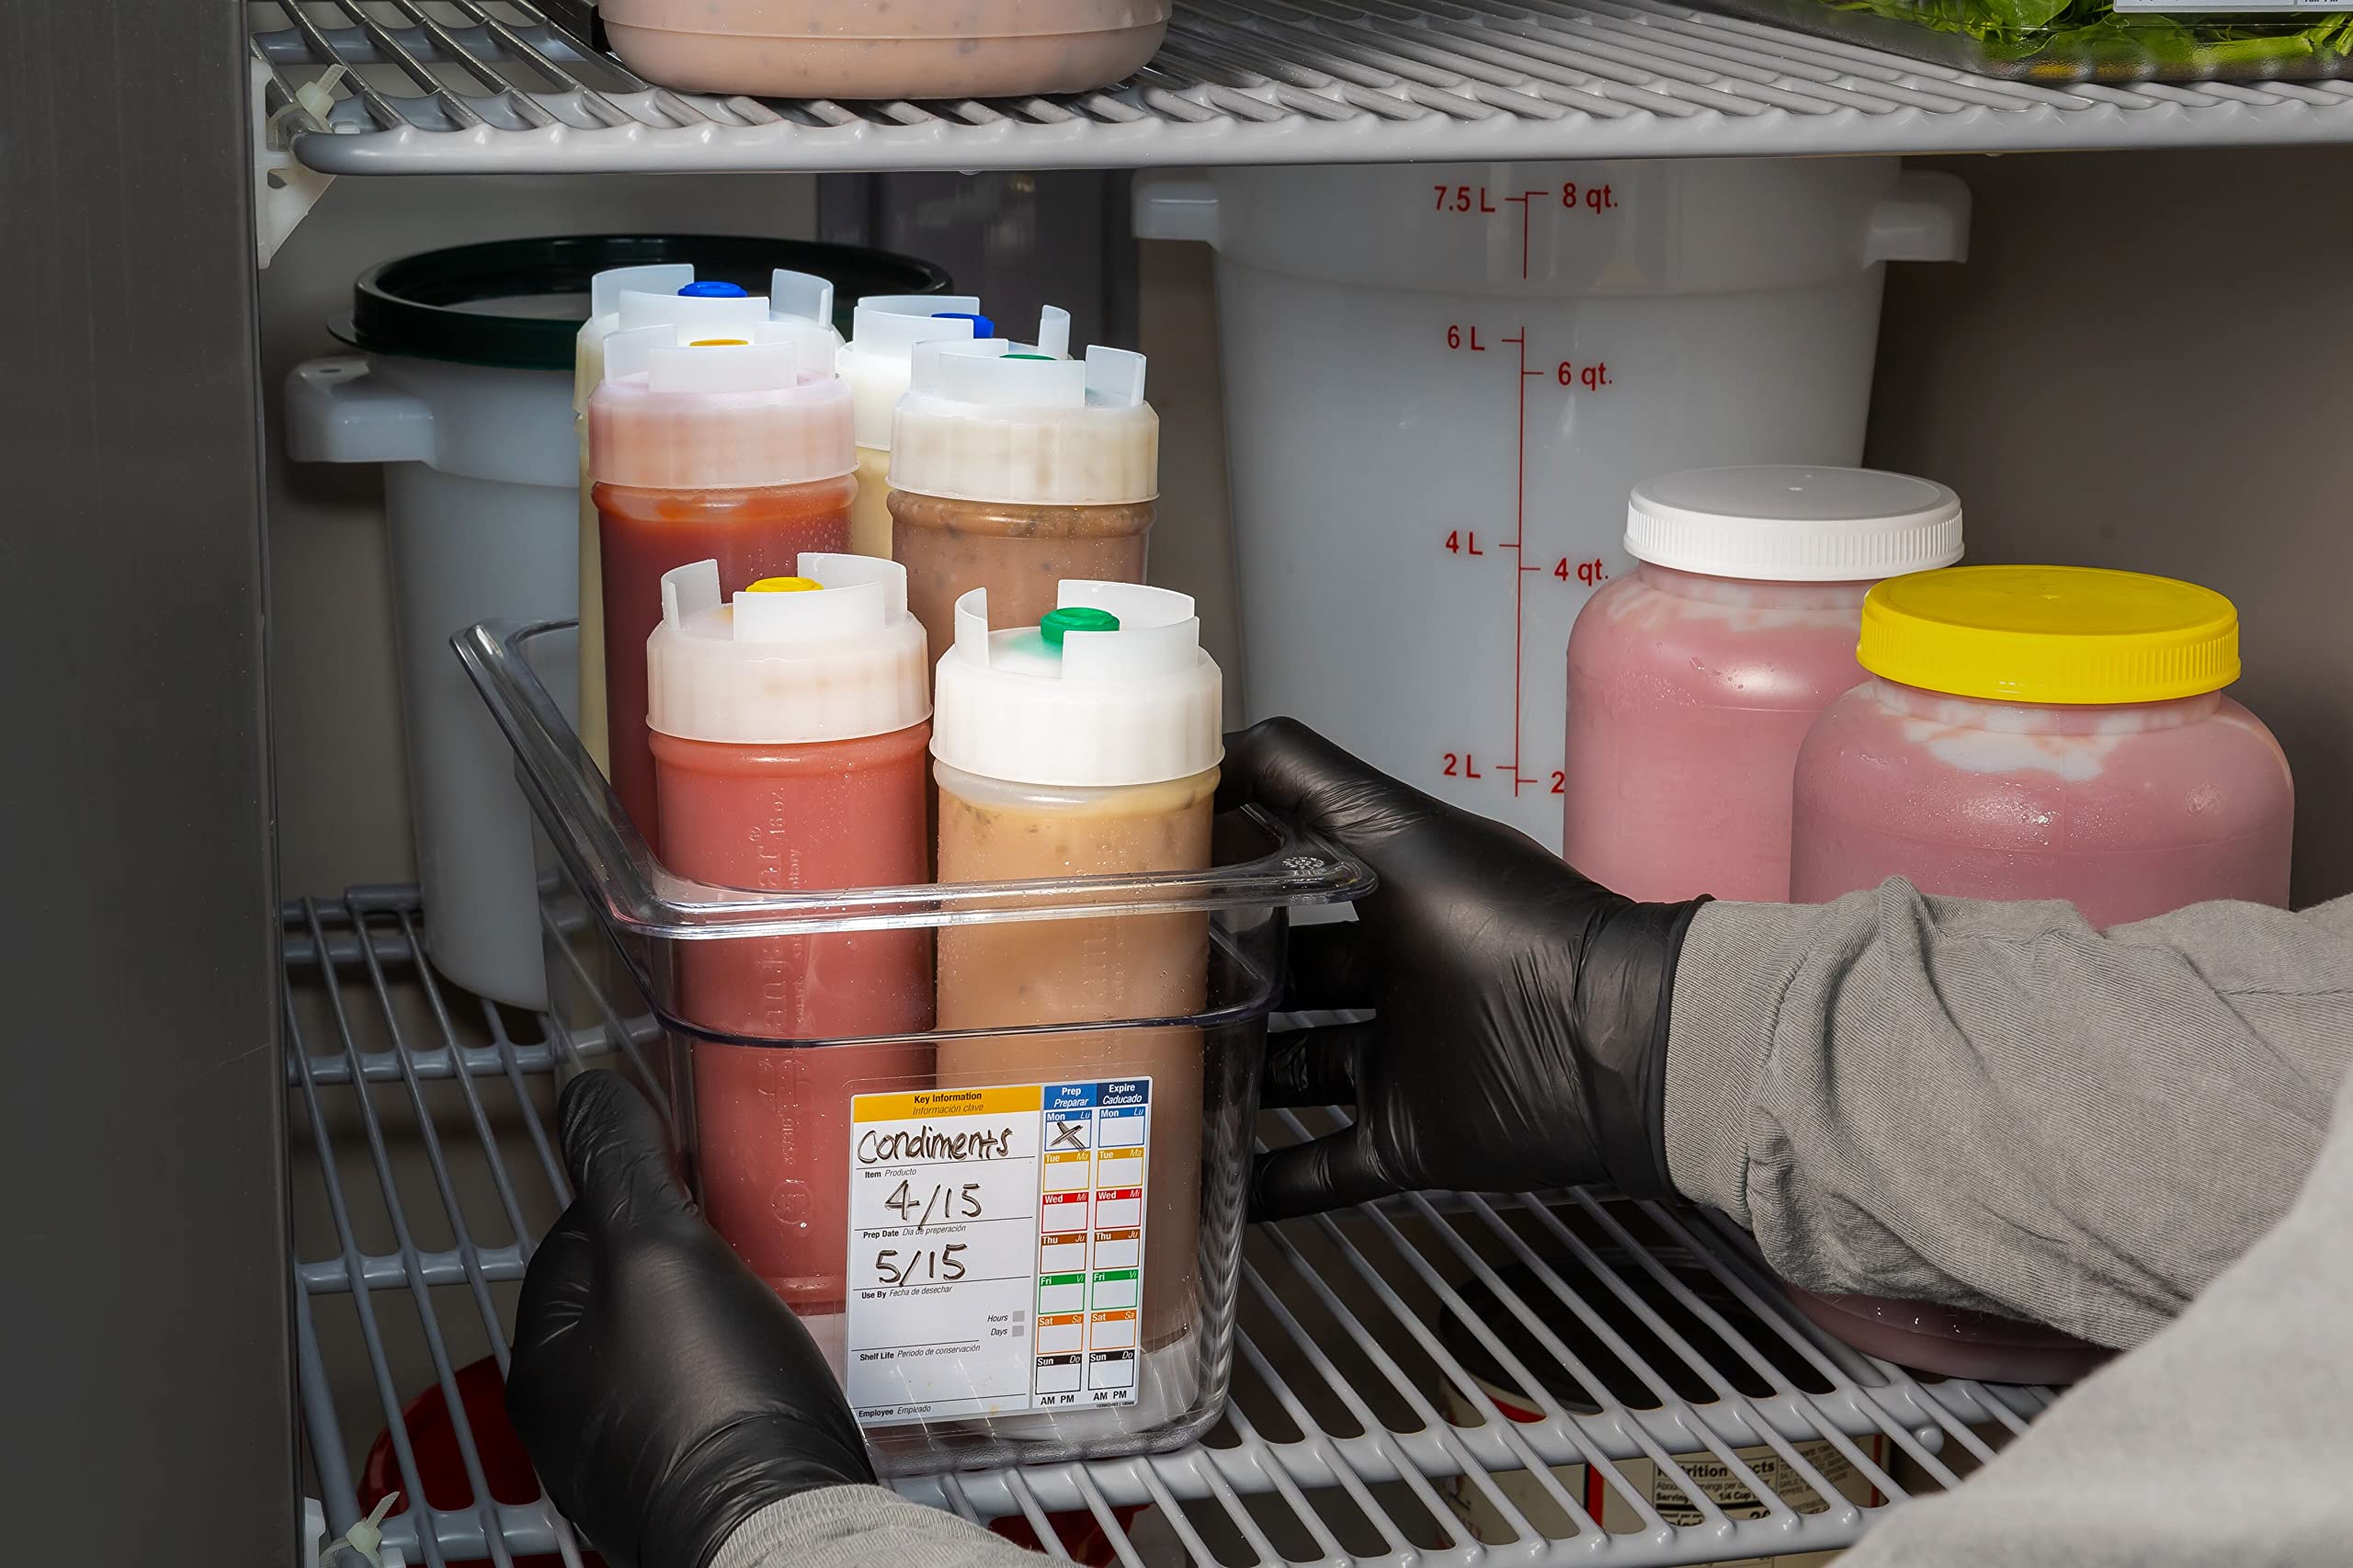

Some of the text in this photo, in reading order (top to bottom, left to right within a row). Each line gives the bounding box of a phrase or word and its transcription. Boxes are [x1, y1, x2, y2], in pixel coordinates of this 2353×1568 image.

[1434, 186, 1496, 213] 7.5 L
[1563, 182, 1619, 215] 8 qt.
[1447, 324, 1485, 351] 6 L
[1558, 361, 1613, 392] 6 qt.
[1445, 530, 1483, 555] 4 L
[1554, 557, 1609, 586] 4 qt.
[1443, 753, 1482, 778] 2 L
[1551, 771, 1565, 794] 2
[1062, 1087, 1082, 1096] Prep
[1108, 1083, 1136, 1094] Expire
[914, 1092, 983, 1105] Key Information
[1053, 1097, 1089, 1108] Preparar
[1102, 1094, 1142, 1105] Caducado
[912, 1103, 984, 1116] Información clave
[1100, 1108, 1144, 1118] Mon Lu
[1046, 1111, 1091, 1121] Mon Lu
[857, 1124, 1014, 1165] Condiments
[1045, 1153, 1088, 1163] Tue Ma
[1098, 1149, 1142, 1159] Tue Ma
[864, 1167, 917, 1178] Item Producto
[1044, 1193, 1086, 1203] Wed Mi
[1098, 1189, 1141, 1199] Wed Mi
[884, 1179, 983, 1231] 4/15
[863, 1231, 881, 1240] Prep
[881, 1229, 900, 1238] Date
[915, 1227, 924, 1235] de
[1042, 1234, 1086, 1244] Thu Ju
[1096, 1231, 1139, 1241] Thu Ju
[875, 1244, 968, 1287] 5/15
[1040, 1275, 1085, 1285] Fri Vi
[1094, 1270, 1137, 1281] Fri Vi
[861, 1286, 953, 1299] Use By Fecha de desechar
[986, 1313, 1008, 1323] Hours
[1039, 1314, 1082, 1326] Sat Sa
[1092, 1311, 1135, 1322] Sat Sa
[990, 1327, 1008, 1336] Days
[859, 1344, 981, 1361] Shelf Life Periodo de conservación
[1090, 1351, 1133, 1362] Sun Do
[1037, 1356, 1081, 1366] Sun Do
[1040, 1394, 1074, 1405] AM PM
[1093, 1390, 1127, 1401] AM PM
[858, 1409, 894, 1418] Employee
